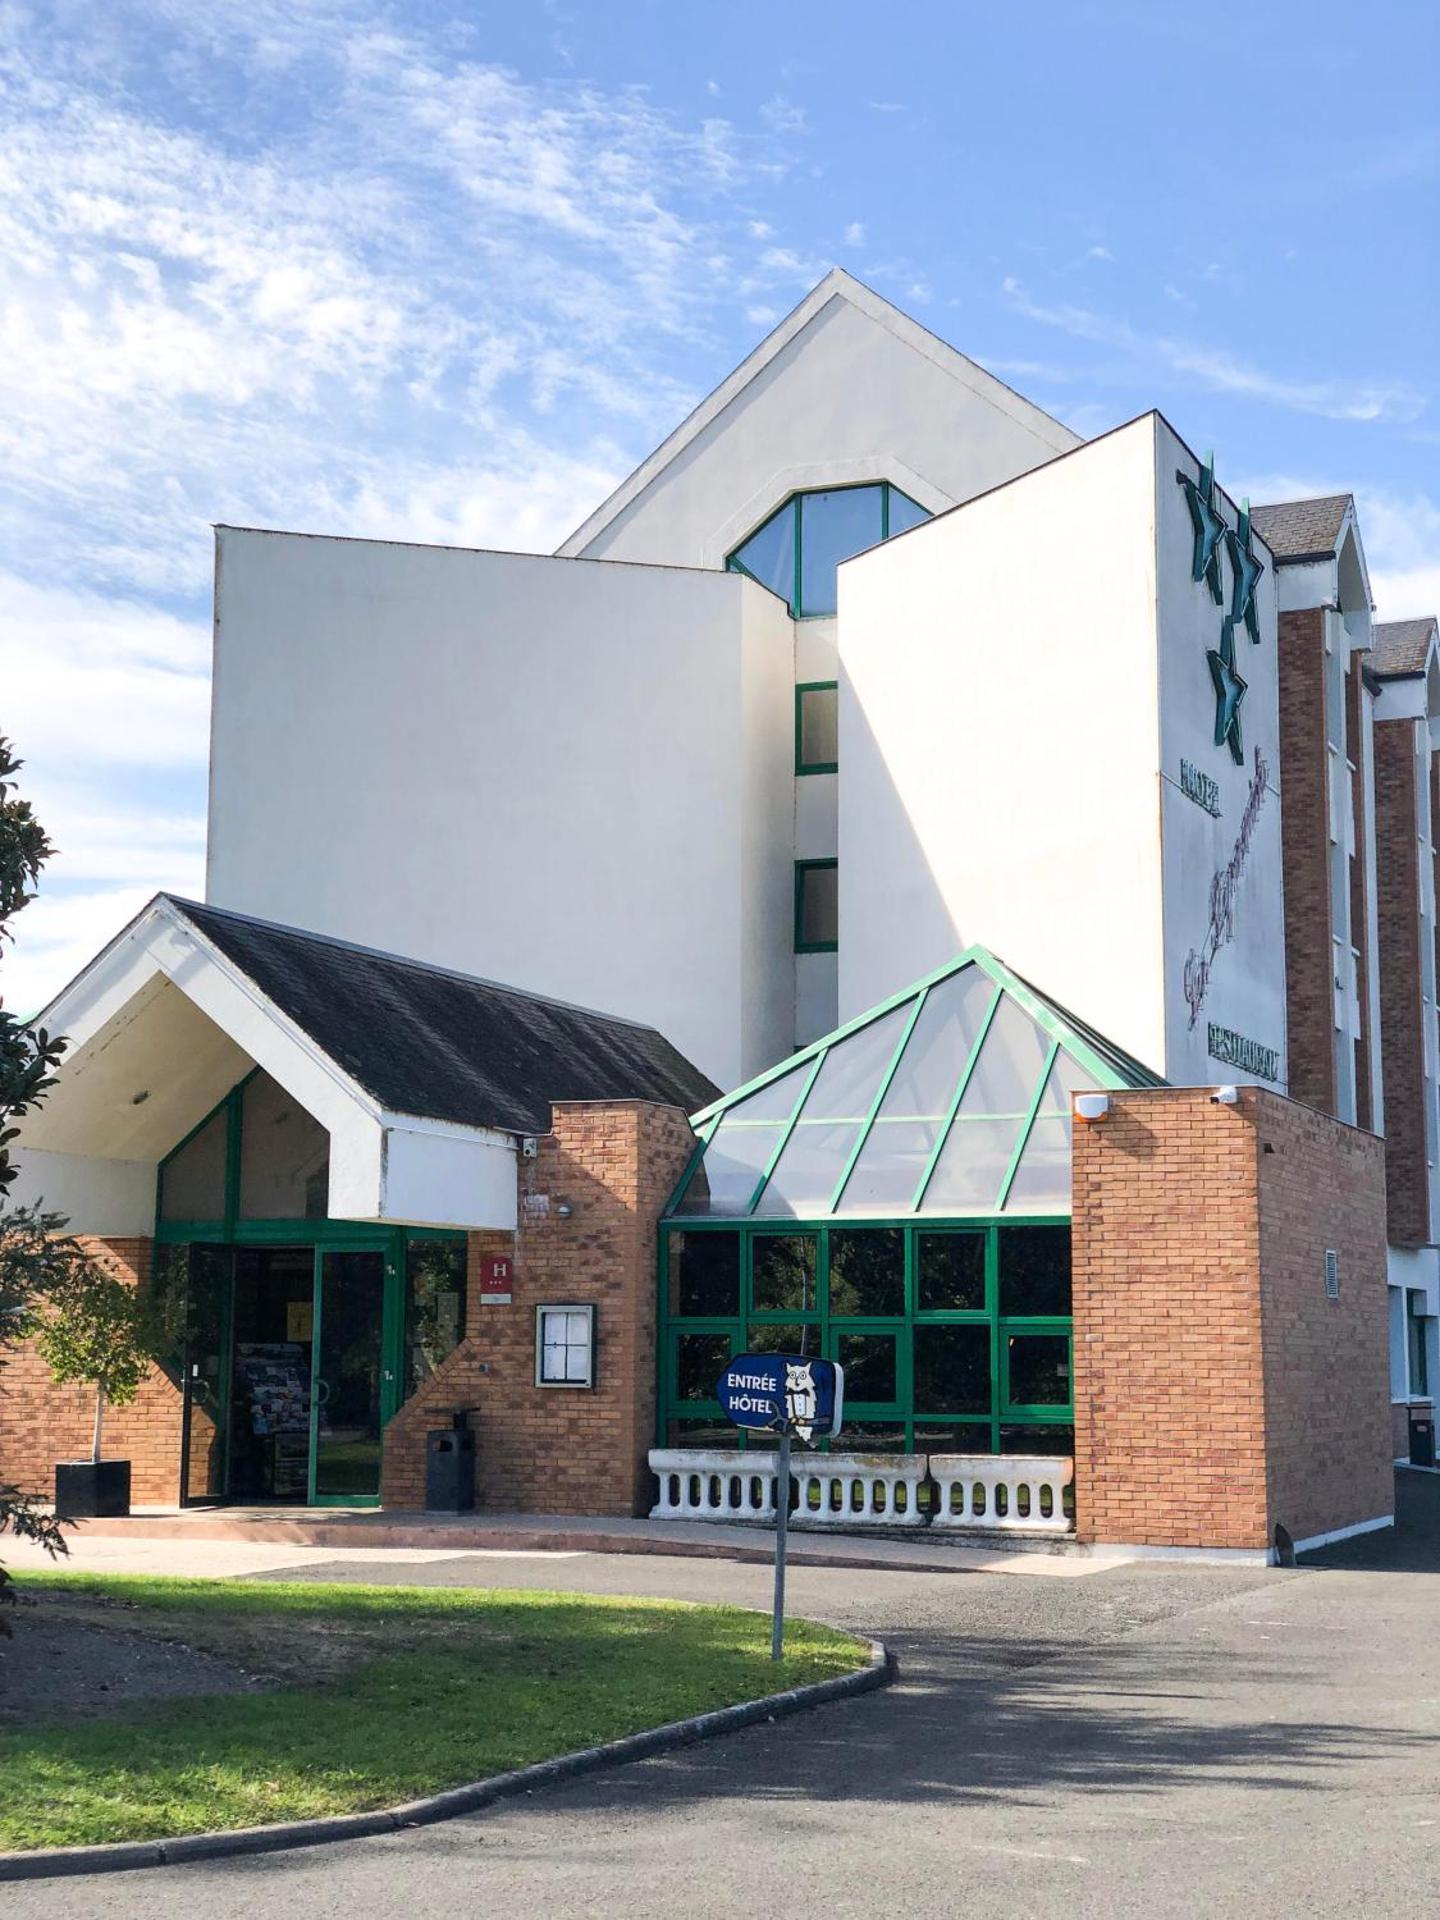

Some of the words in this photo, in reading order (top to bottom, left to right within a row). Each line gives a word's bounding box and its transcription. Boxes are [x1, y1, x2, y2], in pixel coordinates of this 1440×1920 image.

[494, 1263, 506, 1277] H
[727, 1373, 777, 1392] ENTRÉE
[729, 1394, 772, 1414] HÔTEL
